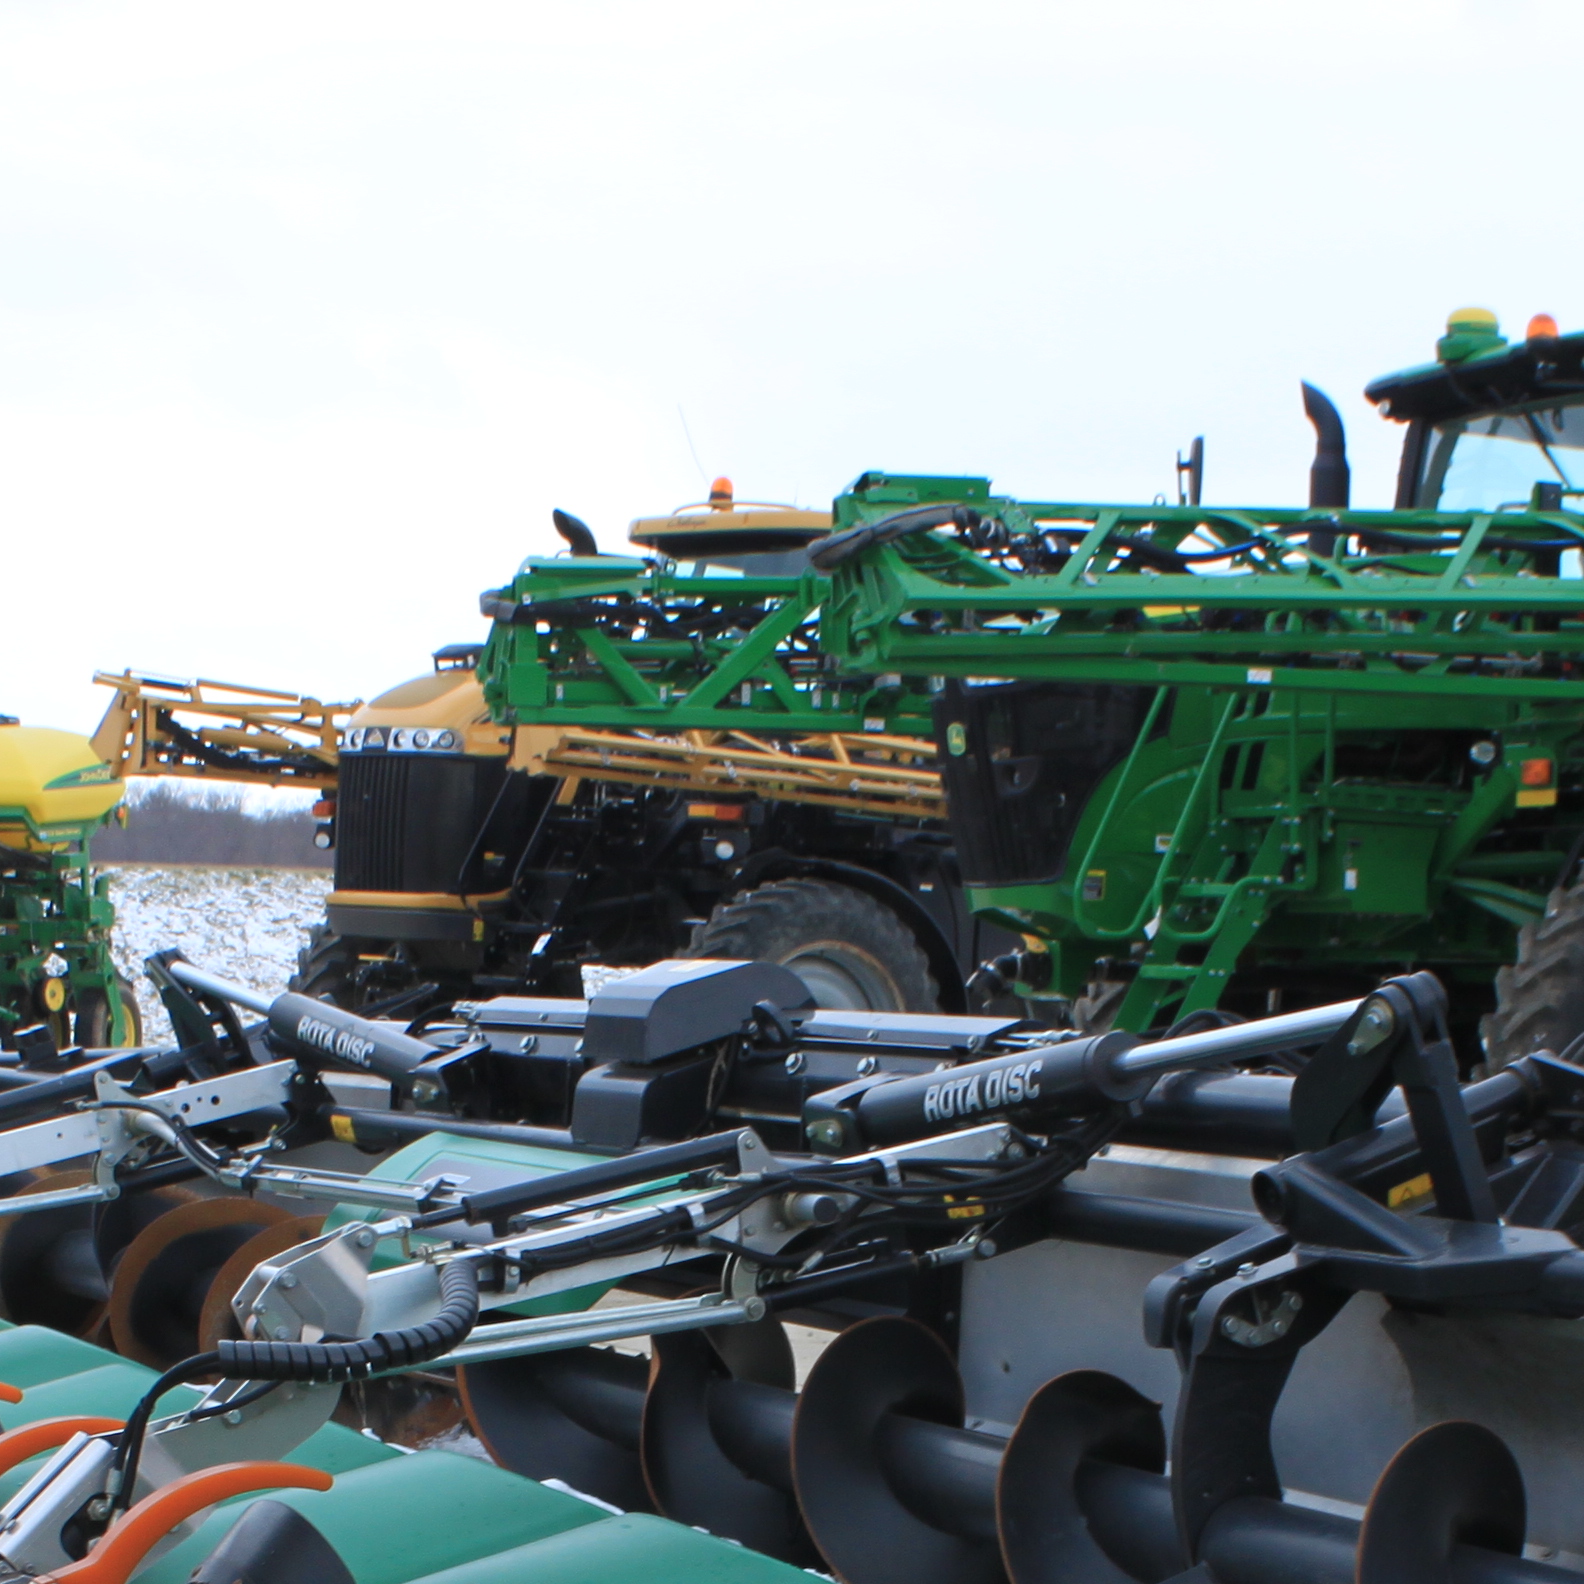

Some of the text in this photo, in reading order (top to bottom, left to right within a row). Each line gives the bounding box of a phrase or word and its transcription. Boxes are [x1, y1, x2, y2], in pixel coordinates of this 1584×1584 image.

[297, 1014, 375, 1068] ROTA DISC
[924, 1059, 1043, 1122] ROTA DISC
